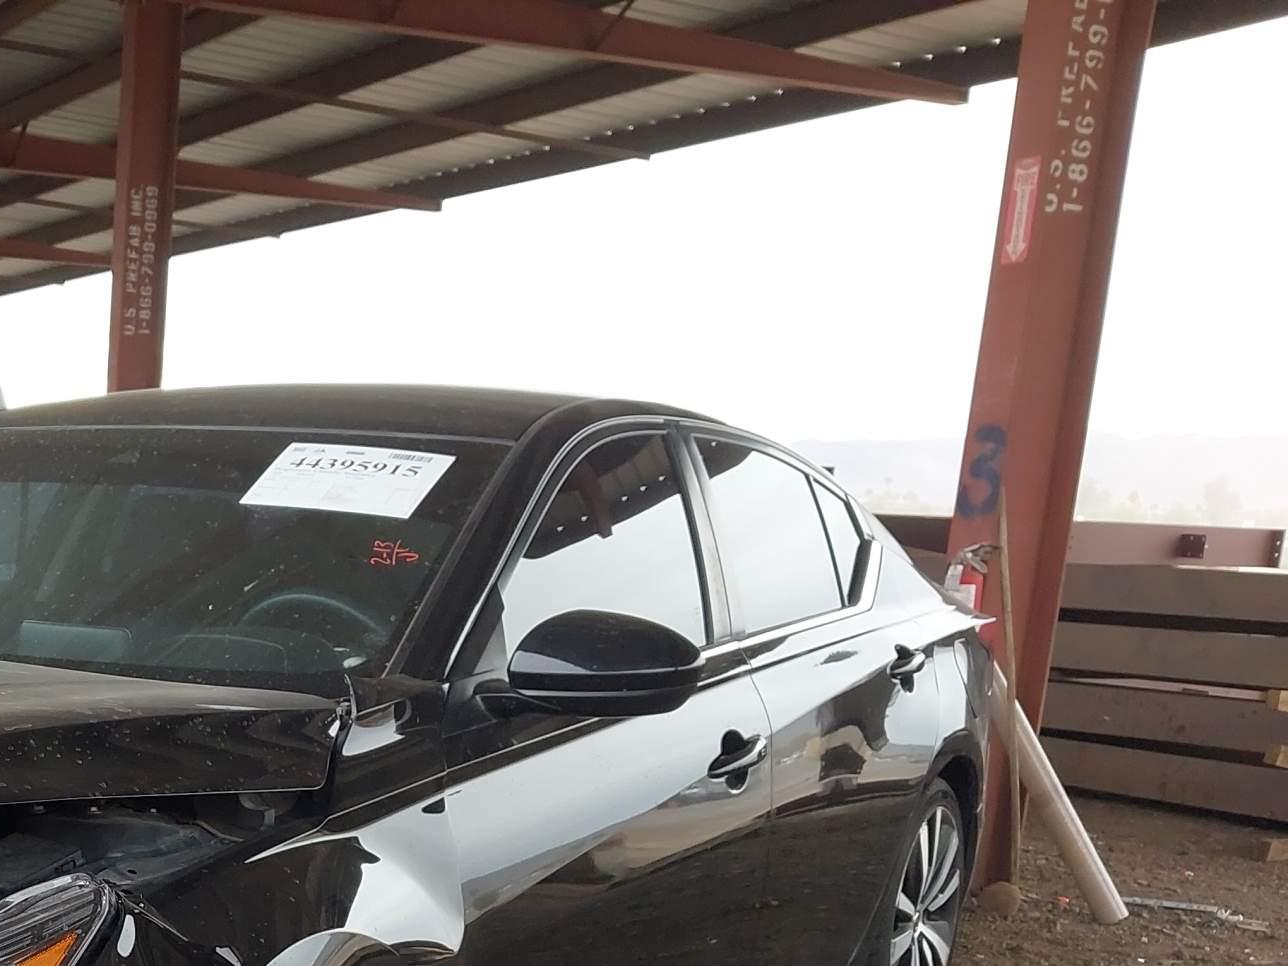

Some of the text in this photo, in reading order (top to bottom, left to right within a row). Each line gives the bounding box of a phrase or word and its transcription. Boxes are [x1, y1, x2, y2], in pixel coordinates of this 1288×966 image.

[125, 223, 142, 293] PREFAB
[289, 456, 423, 478] 44395915
[957, 424, 1006, 518] 3
